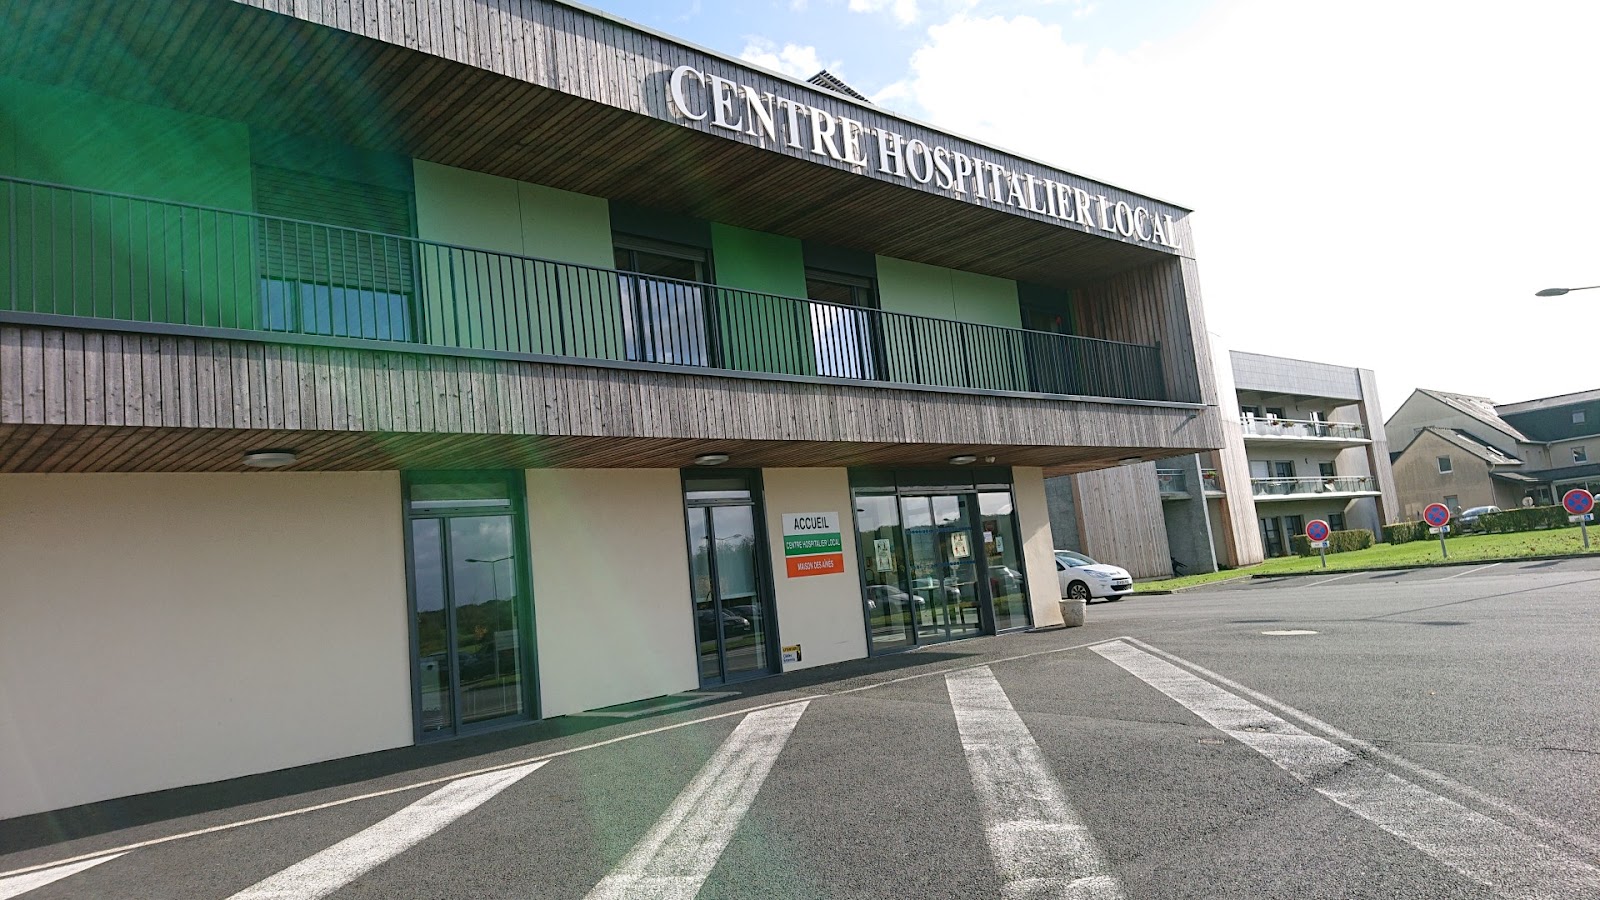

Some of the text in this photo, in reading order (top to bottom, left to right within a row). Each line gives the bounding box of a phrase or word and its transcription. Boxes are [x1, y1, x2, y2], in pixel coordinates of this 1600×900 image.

[670, 65, 1182, 249] CENTRE HOSPITALIER LOCAL
[794, 516, 829, 530] ACCUEIL
[786, 538, 840, 550] CENTRE HOSPITALIER LOCAL
[797, 561, 814, 571] MAISON
[814, 560, 822, 569] DES
